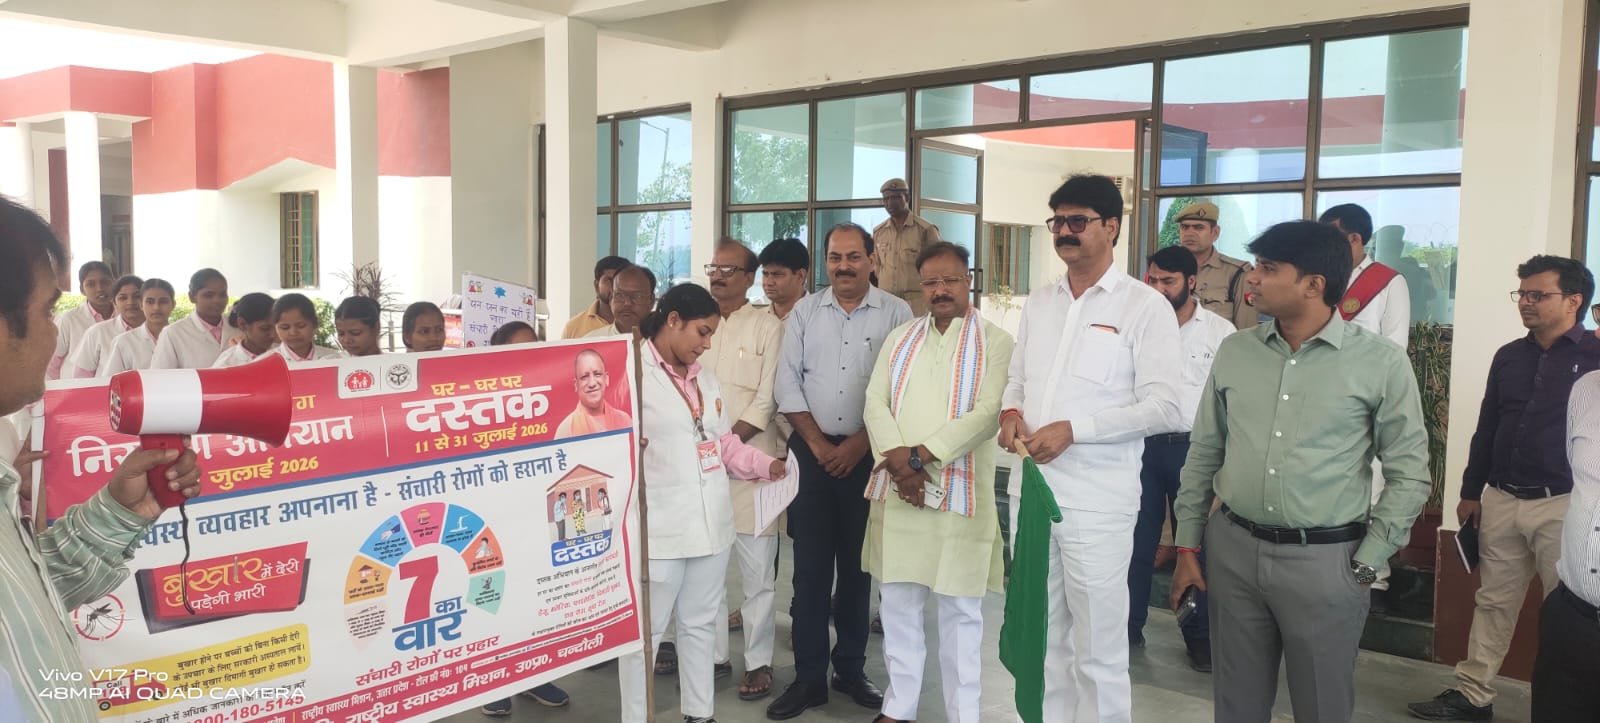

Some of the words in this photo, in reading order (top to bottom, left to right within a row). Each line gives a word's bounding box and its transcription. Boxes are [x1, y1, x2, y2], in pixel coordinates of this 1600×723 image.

[431, 382, 456, 396] घर
[474, 378, 498, 391] घर
[500, 375, 522, 388] पर
[401, 385, 552, 433] दस्तक
[415, 440, 429, 453] 11
[434, 433, 449, 450] से
[454, 435, 467, 447] 31
[472, 422, 517, 449] जुलाई
[521, 422, 548, 437] 2026
[208, 456, 274, 490] जुलाई
[280, 455, 319, 474] 2026
[195, 505, 271, 535] व्यवहार
[278, 490, 358, 523] अपनाना
[362, 481, 378, 507] है
[397, 470, 446, 500] संचारी
[451, 463, 486, 491] रोगों
[488, 460, 508, 484] को
[513, 456, 553, 479] हराना
[555, 450, 568, 471] है
[553, 536, 610, 562] दस्तक
[163, 556, 262, 607] बुखार
[261, 562, 274, 579] में
[275, 557, 300, 577] देरी
[234, 582, 267, 602] भारी
[399, 555, 439, 625] 7
[434, 596, 463, 615] का
[391, 609, 468, 652] वार
[177, 659, 198, 671] बुखार
[213, 652, 222, 661] पर
[356, 660, 403, 686] संचारी
[406, 648, 442, 671] रोगों
[443, 647, 463, 659] पर
[466, 635, 501, 655] प्रहार
[107, 680, 123, 688] Call
[402, 683, 459, 711] स्वास्थ्य
